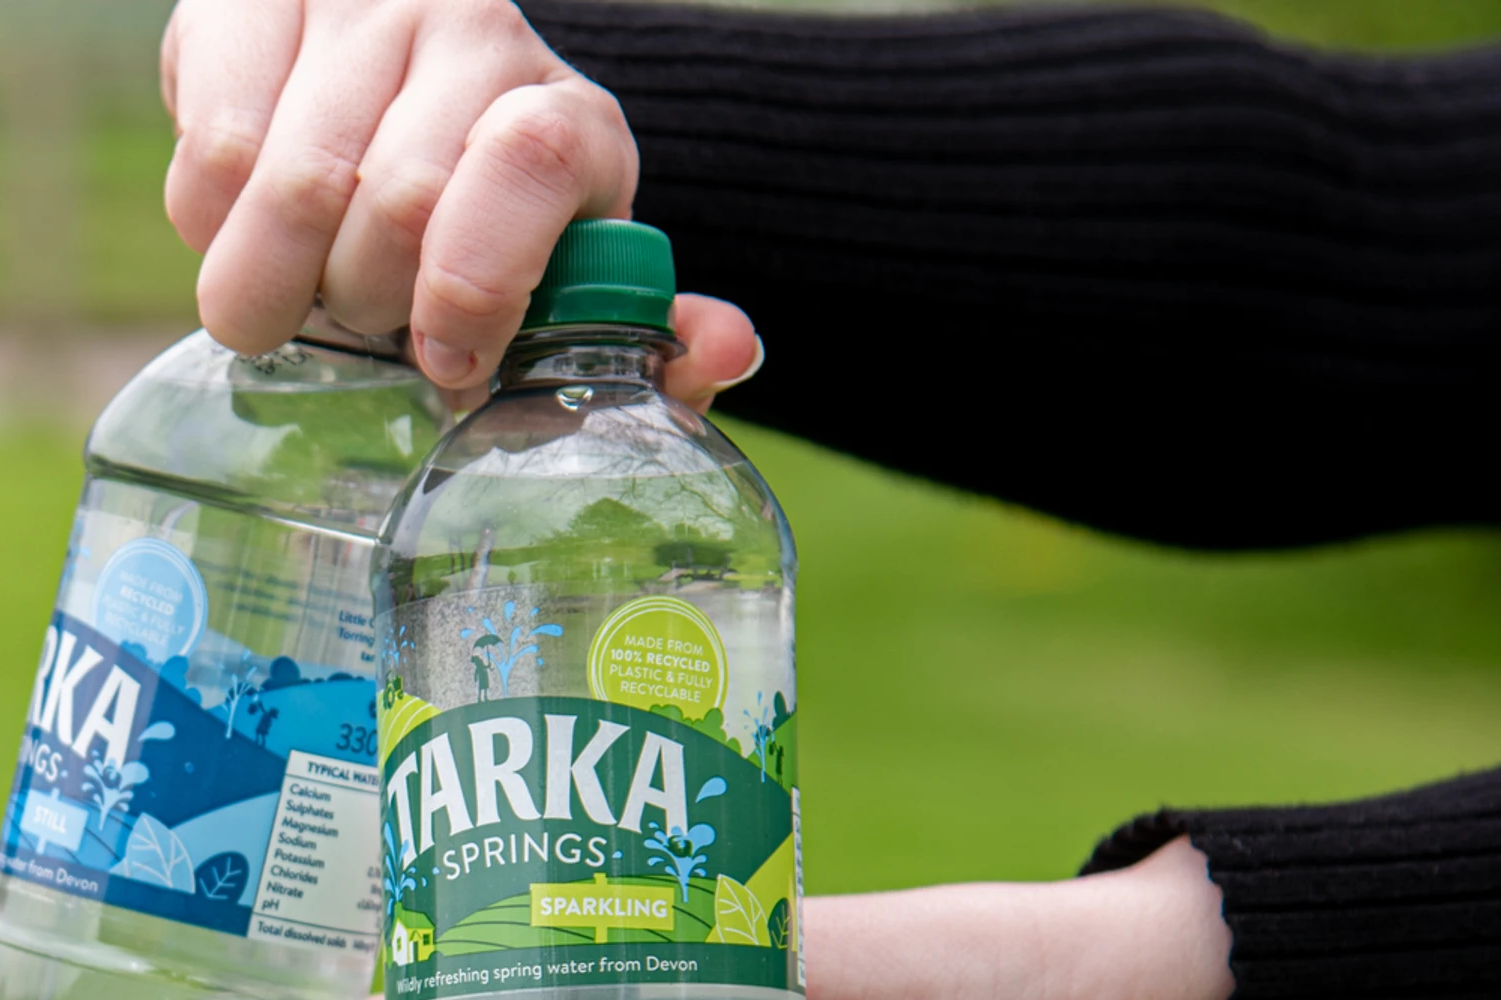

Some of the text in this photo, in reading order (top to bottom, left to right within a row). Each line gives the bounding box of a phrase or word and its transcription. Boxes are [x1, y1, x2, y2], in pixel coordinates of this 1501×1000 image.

[120, 585, 175, 615] RECYCLED
[339, 610, 366, 627] Little
[624, 635, 704, 656] MADE FROM
[611, 649, 710, 673] 100% RECYCLED
[609, 664, 713, 688] PLASTIC & FULLY
[620, 680, 701, 703] RECYCLABLE
[307, 761, 350, 781] TYPICAL
[290, 783, 331, 803] Calcium
[387, 714, 689, 869] TARKA
[33, 804, 67, 834] STILL
[286, 799, 334, 820] Sulphates
[282, 816, 339, 838] Magnesium
[278, 832, 317, 850] Sodium
[274, 848, 325, 868] Potassium
[442, 832, 608, 881] SPRINGS
[28, 859, 54, 880] from
[55, 867, 98, 894] Devon
[270, 863, 318, 885] Chlorides
[266, 881, 304, 899] Nitrate
[261, 899, 279, 911] pH
[539, 897, 669, 919] SPARKLING
[257, 920, 283, 937] Total
[284, 926, 325, 946] dissolved
[397, 955, 698, 995] Wildly refreshing spring water from Devon
